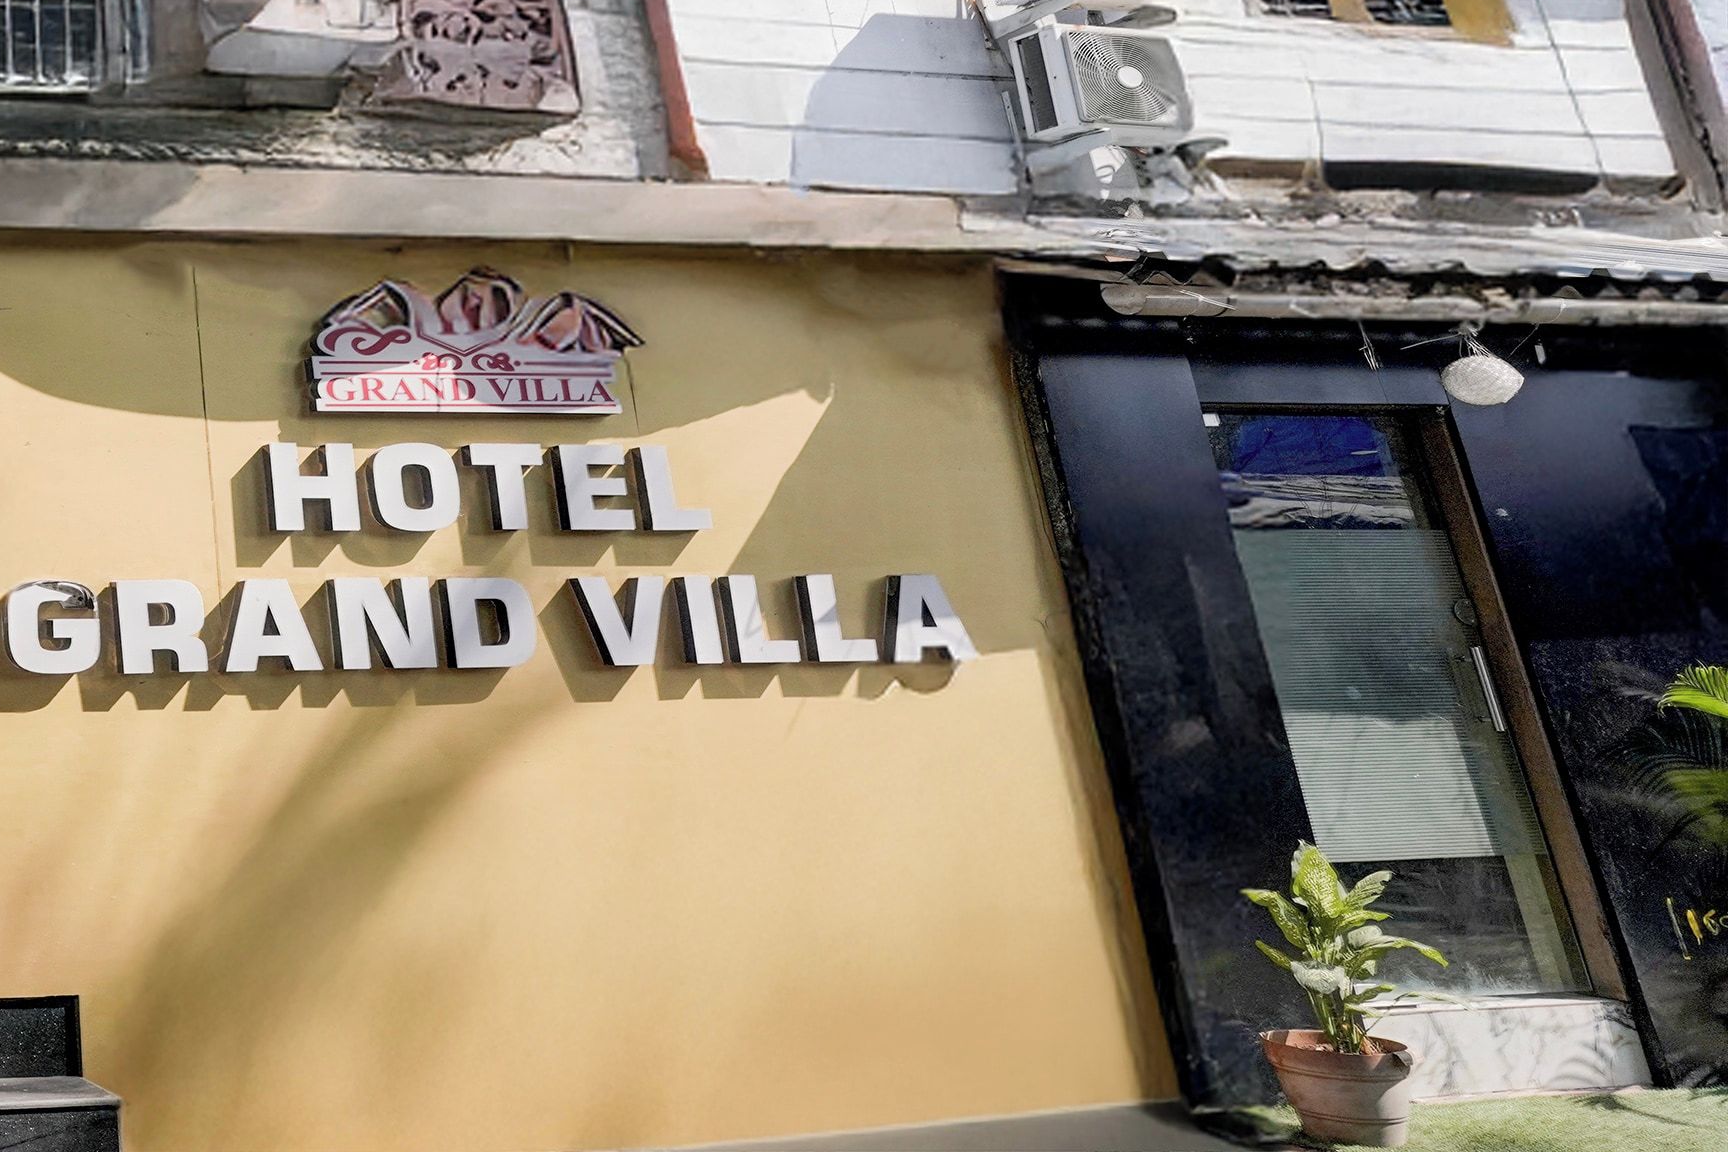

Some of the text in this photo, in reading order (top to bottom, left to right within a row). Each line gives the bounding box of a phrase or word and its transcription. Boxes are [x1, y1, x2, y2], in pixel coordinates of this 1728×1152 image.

[326, 377, 615, 402] GRAND VILLA
[265, 442, 713, 533] HOTEL
[4, 577, 540, 676] GRAND
[574, 573, 977, 670] VILLA
